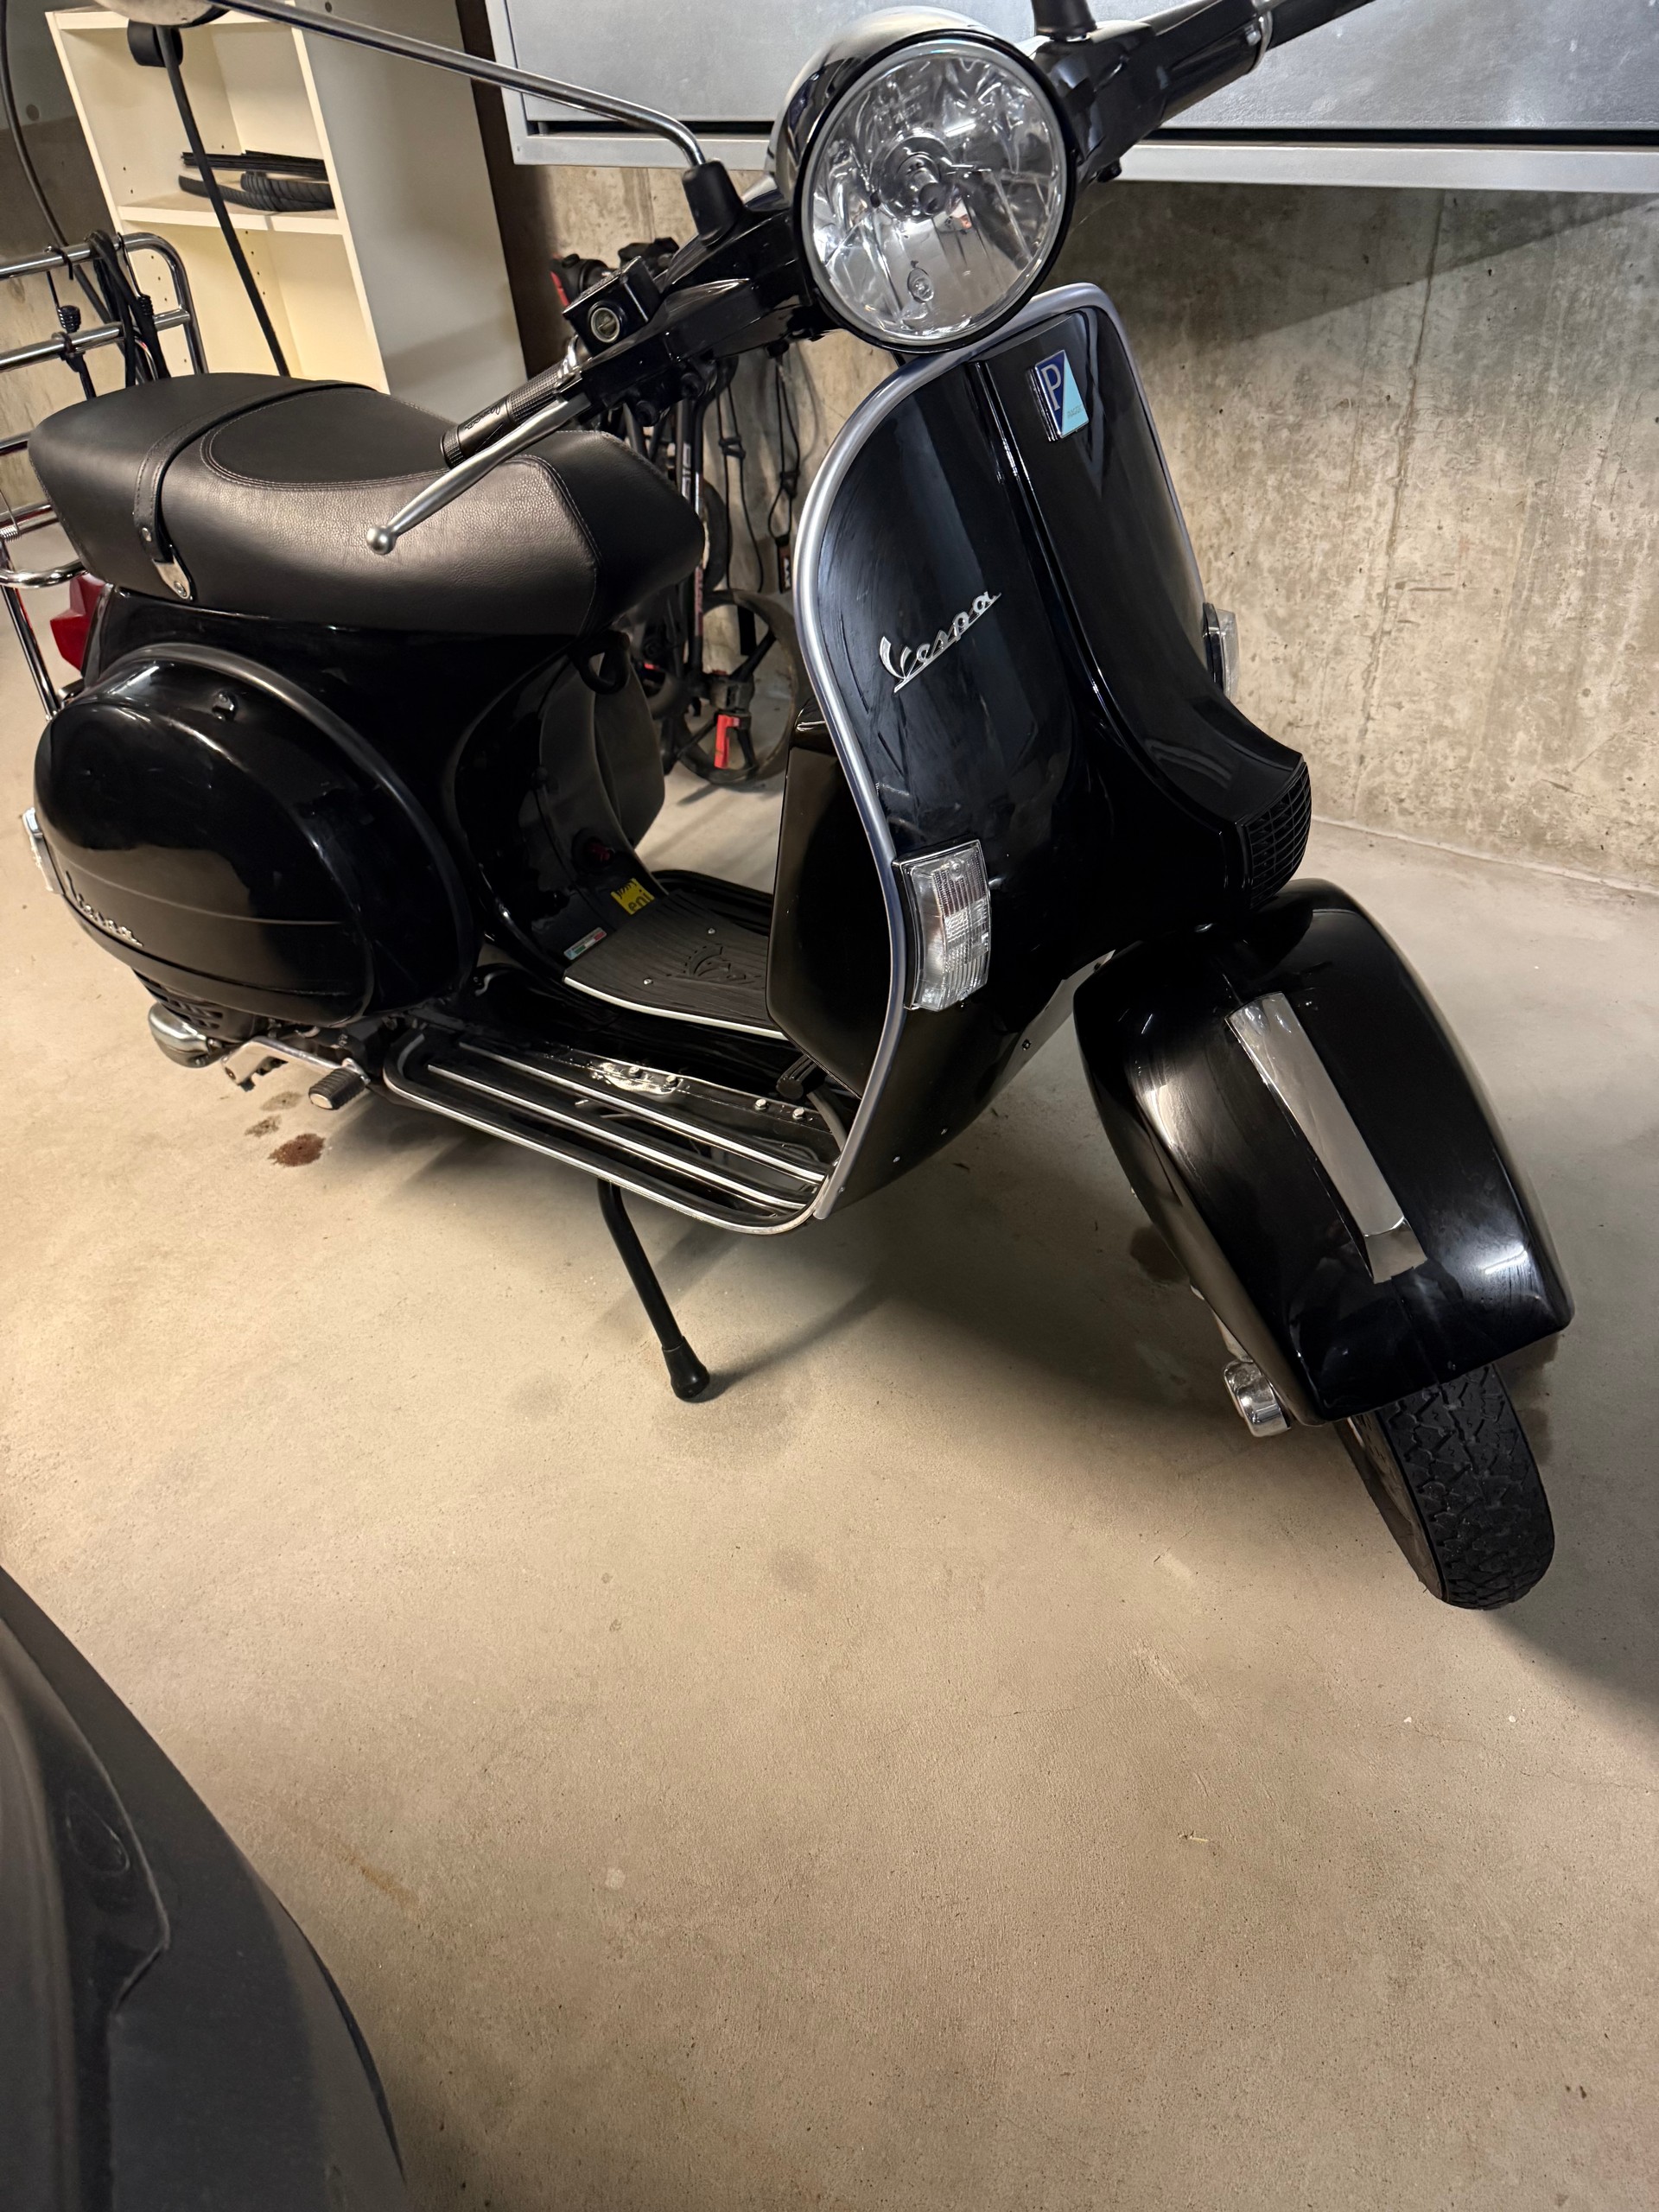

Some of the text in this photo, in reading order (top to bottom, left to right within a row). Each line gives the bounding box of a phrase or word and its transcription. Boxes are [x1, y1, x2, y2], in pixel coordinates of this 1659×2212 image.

[1040, 364, 1062, 411] P
[879, 590, 1002, 694] Vespa
[628, 888, 652, 911] eni
